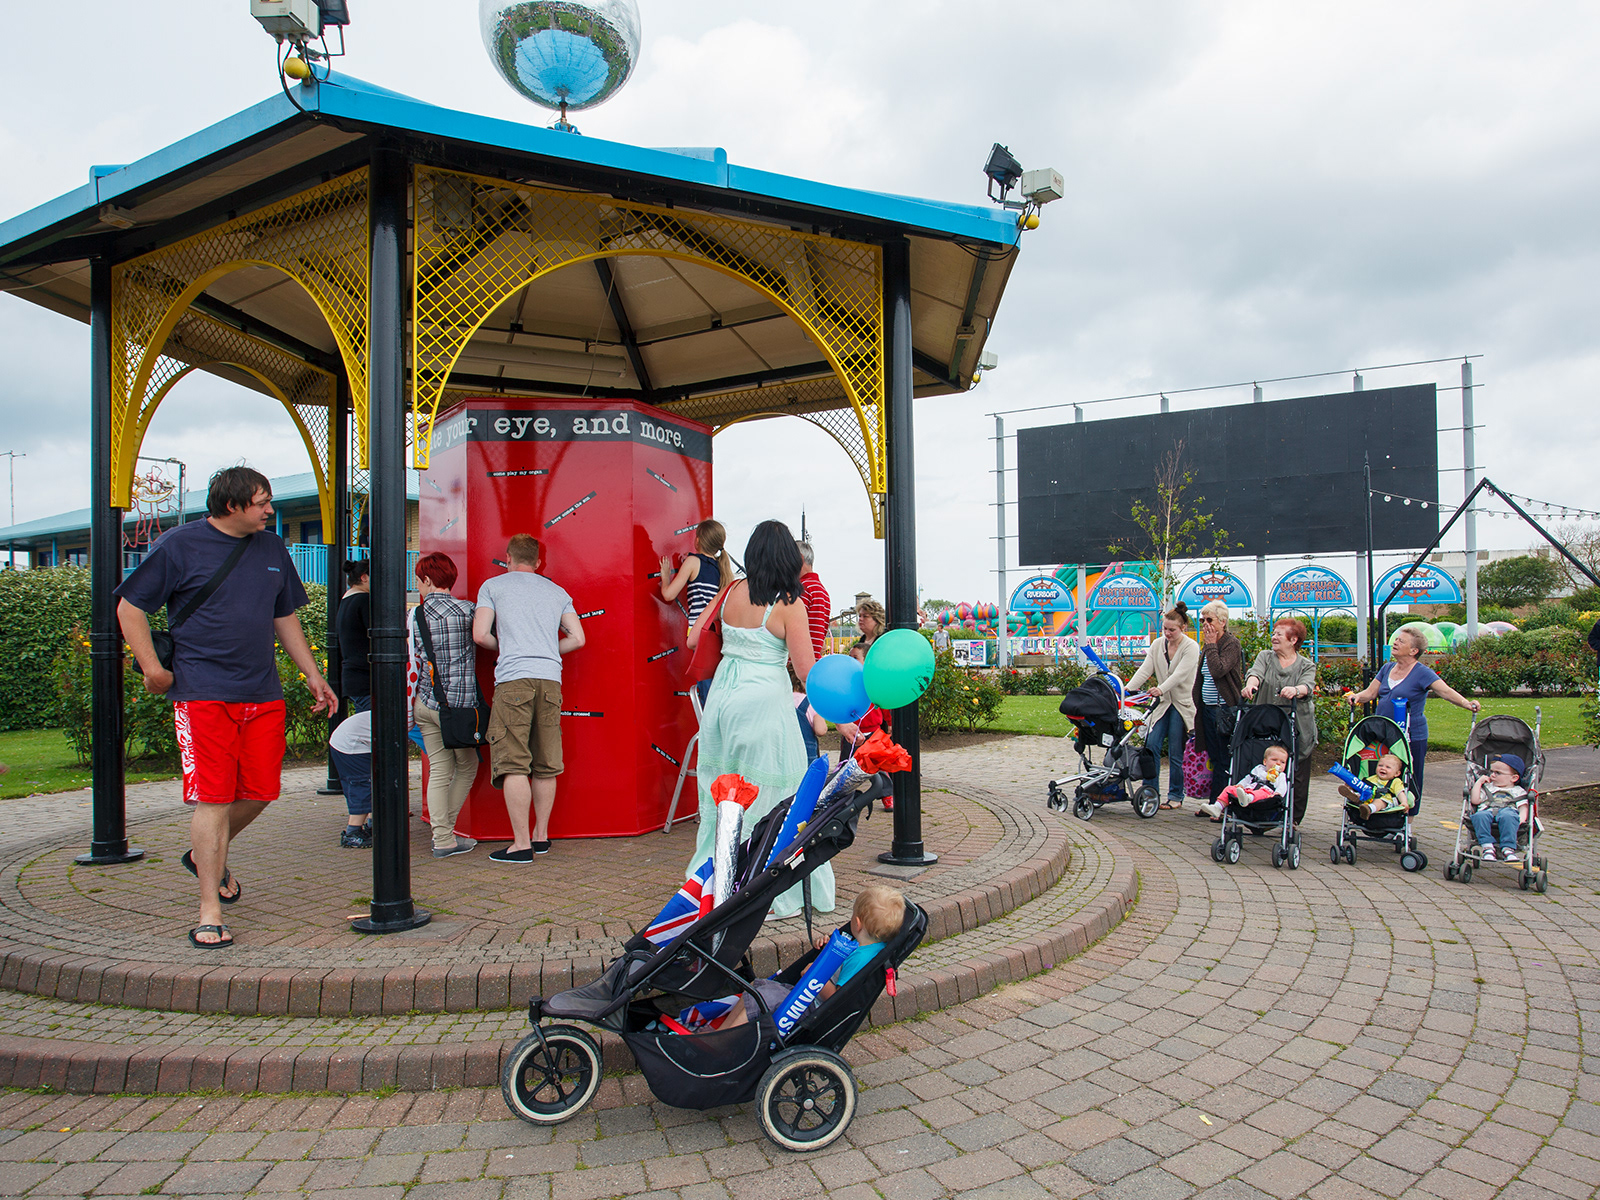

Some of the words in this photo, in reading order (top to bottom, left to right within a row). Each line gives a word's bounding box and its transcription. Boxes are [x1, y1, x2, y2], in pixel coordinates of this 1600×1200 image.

[445, 417, 478, 447] your
[494, 417, 557, 439] eye,
[572, 412, 631, 434] and
[640, 421, 685, 449] more.
[1280, 580, 1341, 592] WATERWAY
[1394, 579, 1437, 589] RVERBOAT
[1026, 590, 1058, 599] RIVERBOAT
[1098, 587, 1151, 597] WATERWAY
[1195, 585, 1232, 595] RIVERBOAT
[1097, 596, 1124, 606] BOAT
[1127, 596, 1152, 606] RIDE
[1279, 591, 1310, 602] BOAT
[1314, 590, 1342, 601] RIDE
